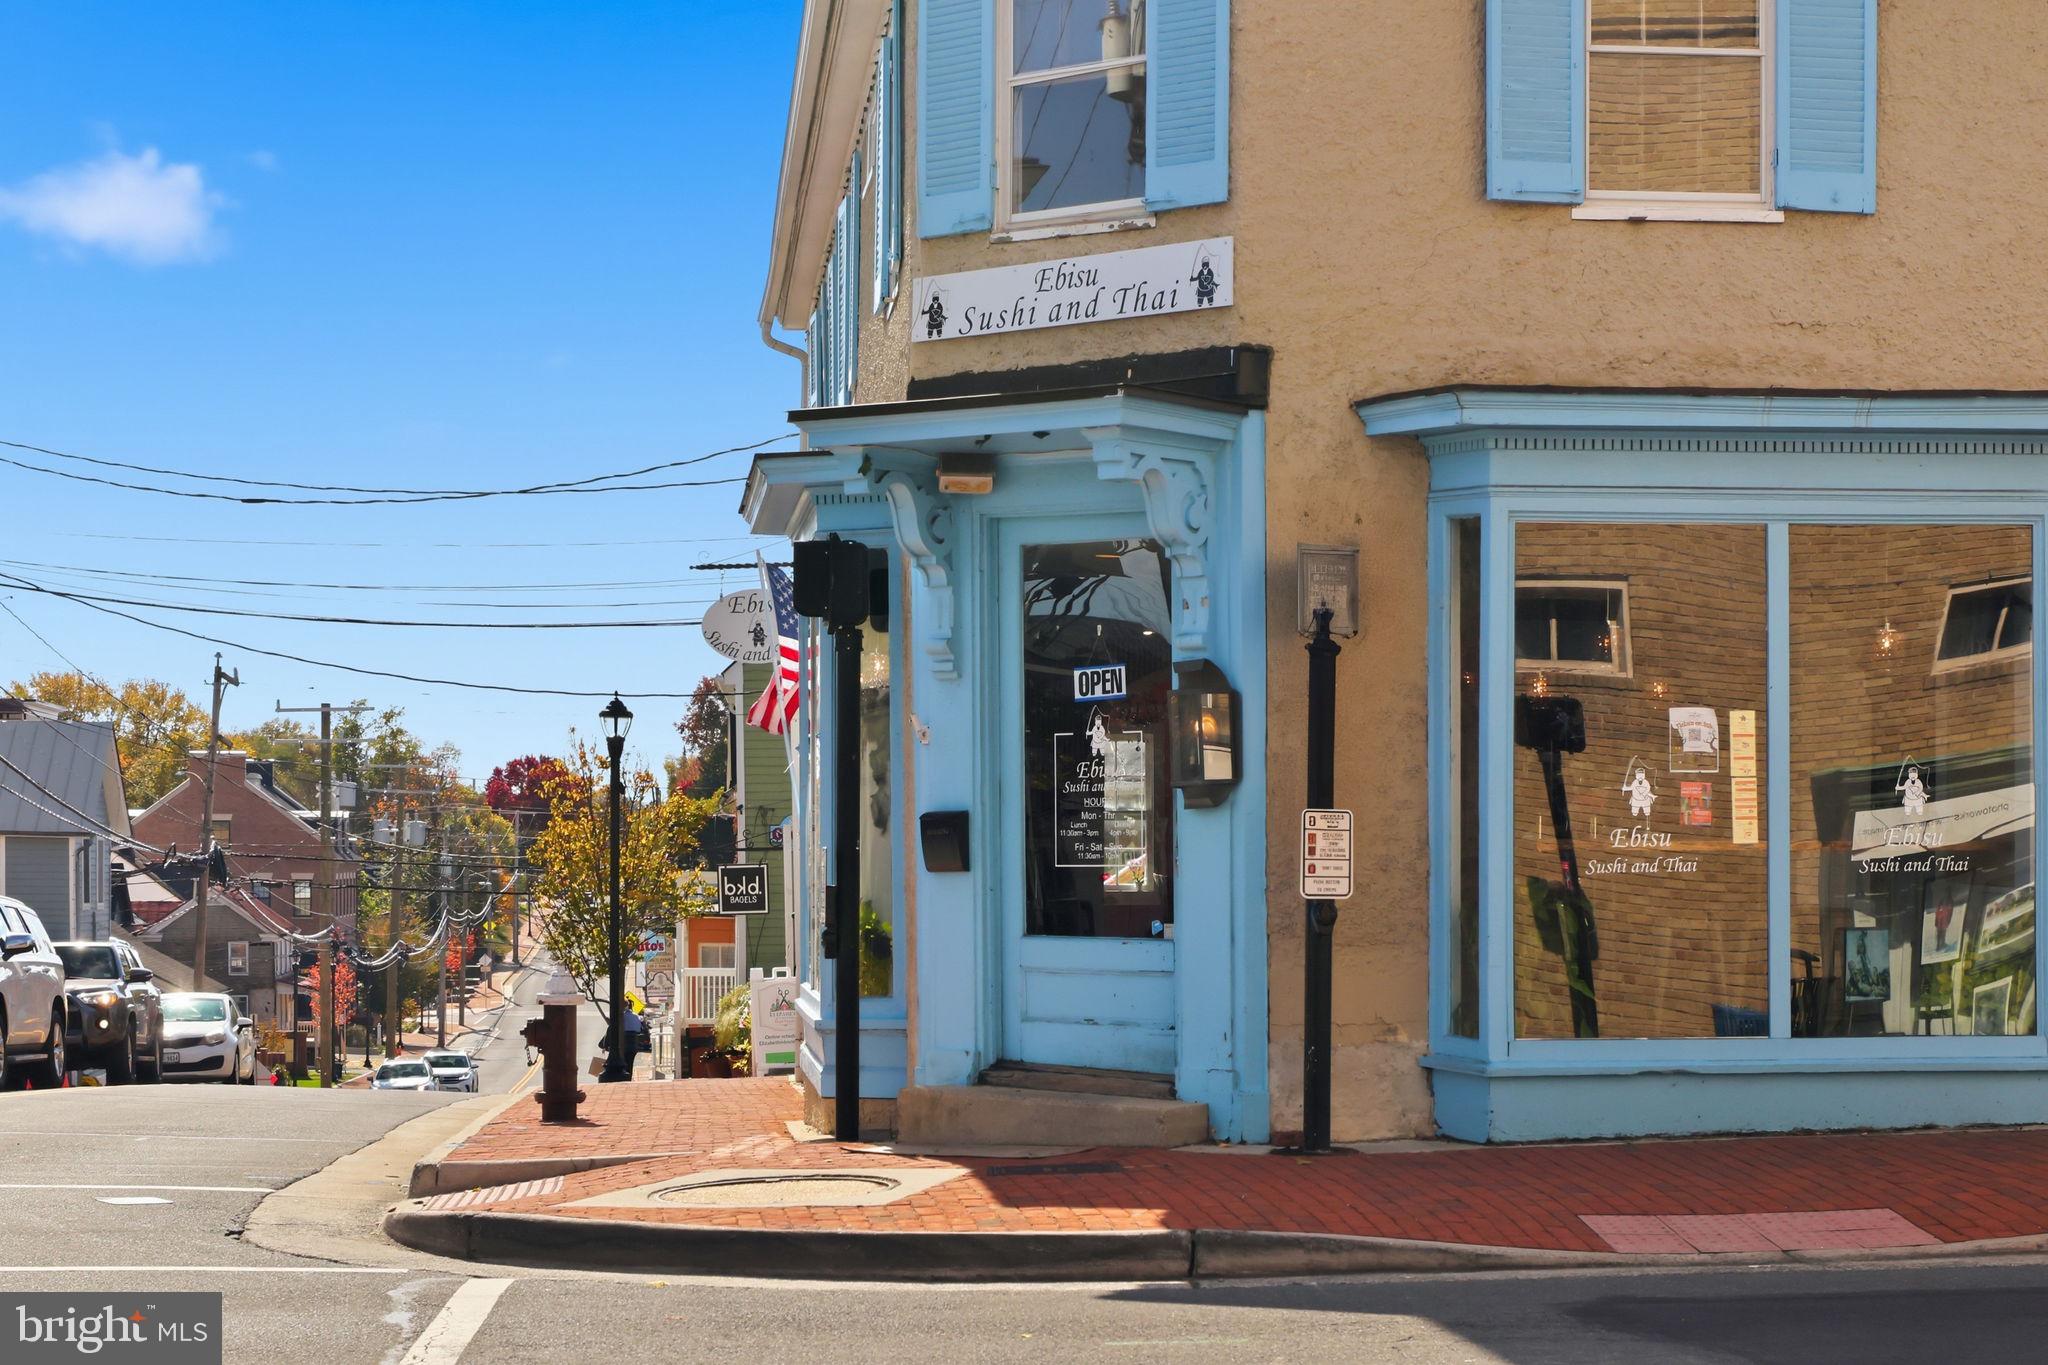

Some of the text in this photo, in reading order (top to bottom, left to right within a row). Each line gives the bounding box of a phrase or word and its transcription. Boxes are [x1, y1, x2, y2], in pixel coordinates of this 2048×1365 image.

[1034, 262, 1100, 293] Ebisu
[958, 280, 1179, 335] Sushi and Thai
[704, 628, 772, 662] Sushi and
[1078, 668, 1123, 697] OPEN
[1062, 780, 1091, 794] Sushi
[1081, 811, 1097, 820] Mon
[1610, 825, 1672, 849] Ebisu
[1883, 823, 1944, 848] Ebisu
[1585, 856, 1698, 876] Sushi and Thai
[1858, 855, 1970, 874] Sushi and Thai
[729, 895, 757, 904] BAGELS
